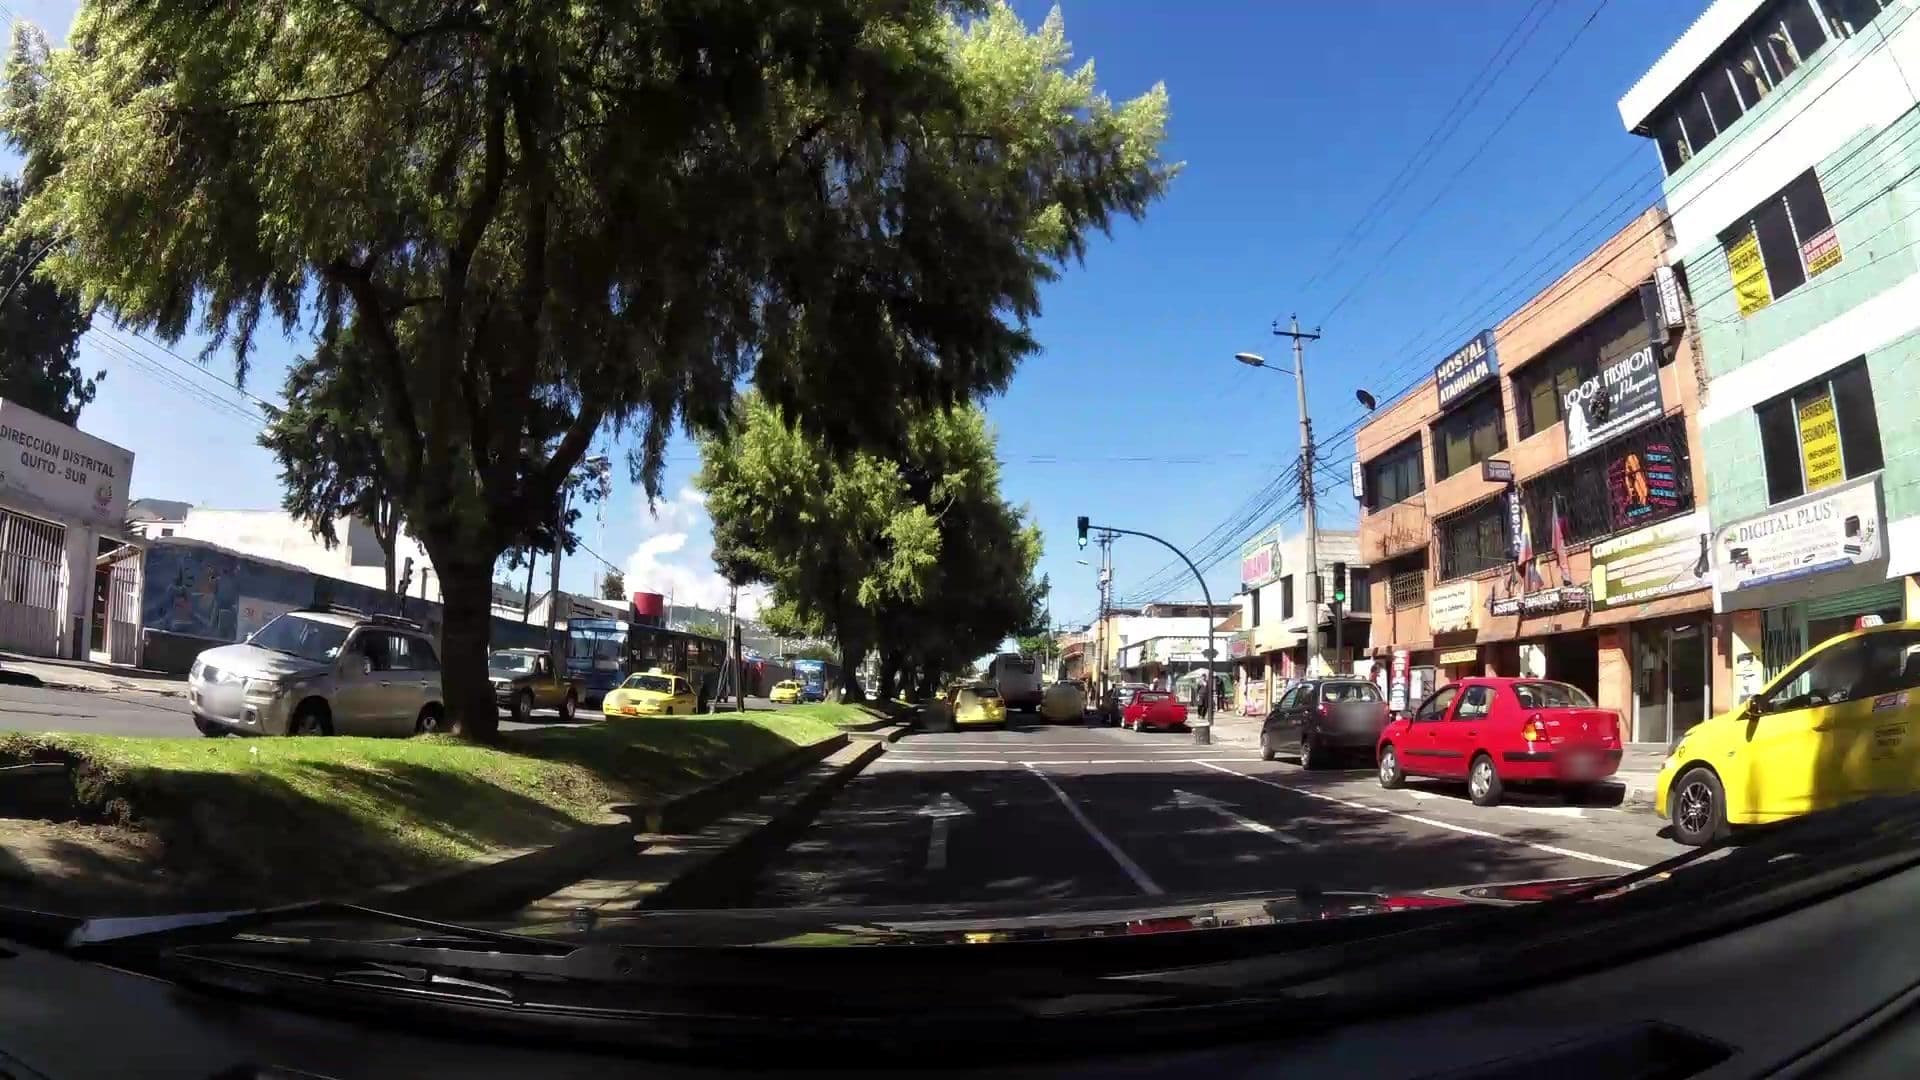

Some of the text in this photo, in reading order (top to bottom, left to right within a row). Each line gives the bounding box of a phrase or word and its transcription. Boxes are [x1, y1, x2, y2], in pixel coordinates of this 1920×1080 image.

[1438, 339, 1486, 385] HOSTAL
[1604, 346, 1653, 387] FASHION
[1440, 361, 1489, 405] ATAHUALPA
[21, 452, 56, 475] QUITO
[65, 467, 87, 485] SUR
[62, 449, 116, 478] DISTRITAL
[1739, 502, 1832, 542] DIGITAL PLUS
